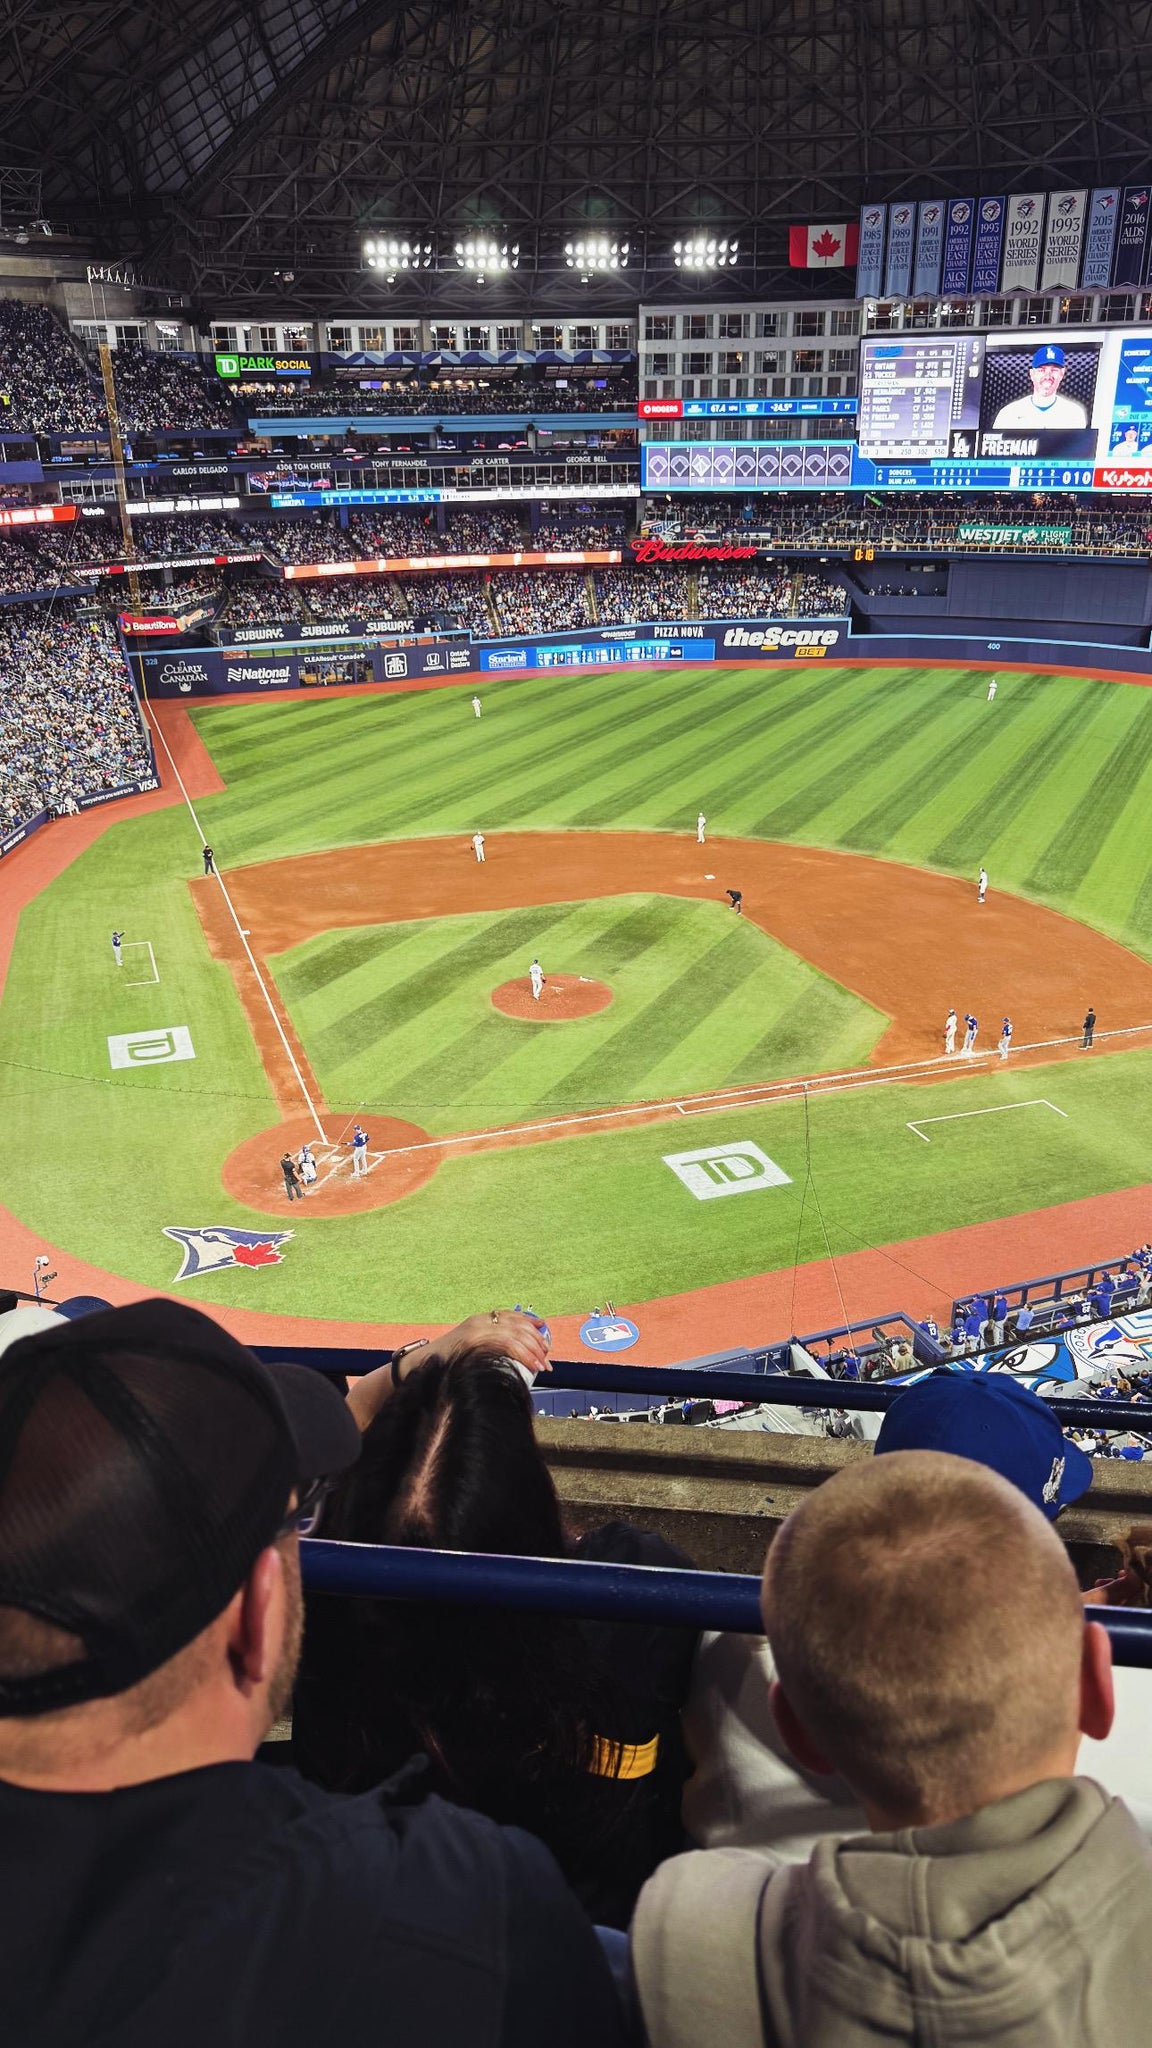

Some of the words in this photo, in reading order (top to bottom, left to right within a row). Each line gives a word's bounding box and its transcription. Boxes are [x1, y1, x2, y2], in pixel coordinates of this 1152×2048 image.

[1093, 215, 1113, 226] 2015
[1124, 214, 1145, 224] 2016
[950, 225, 969, 235] 1992
[981, 223, 1000, 233] 1993
[1010, 220, 1039, 236] 1992
[1051, 217, 1080, 233] 1993
[864, 231, 881, 240] 1985
[892, 229, 910, 239] 1989
[922, 227, 938, 237] 1991
[1123, 227, 1145, 237] ALDS
[1008, 238, 1038, 249] WORLD
[1049, 235, 1079, 246] WORLD
[1090, 235, 1112, 243] LEAGUE
[1121, 237, 1144, 245] CHAMPS
[890, 247, 910, 255] LEAGUE
[948, 244, 968, 252] LEAGUE
[978, 242, 999, 250] LEAGUE
[1089, 243, 1111, 251] EAST
[861, 248, 880, 256] LEAGUE
[947, 252, 968, 260] EAST
[977, 250, 998, 259] EAST
[1006, 249, 1037, 260] SERIES
[1047, 246, 1078, 257] SERIES
[889, 255, 909, 263] EAST
[919, 254, 938, 262] EAST
[1006, 258, 1036, 267] CHAMPIONS
[1046, 256, 1077, 265] CHAMPIONS
[1087, 264, 1108, 274] ALDS
[946, 272, 966, 282] ALCS
[976, 270, 996, 280] ALCS
[1085, 274, 1107, 282] CHAMPS
[974, 280, 996, 288] CHAMPS
[972, 342, 979, 354] 5
[217, 358, 237, 374] TD
[240, 357, 274, 369] PARK
[275, 360, 311, 370] SOCIAL
[652, 405, 678, 413] ROGERS
[833, 403, 838, 411] 7
[981, 438, 1038, 456] FREEMAN
[276, 462, 293, 471] 4306
[294, 462, 309, 471] TOM
[310, 462, 331, 470] CHEEK
[372, 460, 390, 468] TONY
[392, 459, 427, 467] FERNANDEZ
[172, 467, 197, 476] CARLOS
[199, 466, 228, 474] DELGADO
[888, 478, 903, 486] BLUE
[903, 478, 917, 486] JAYS
[959, 528, 1022, 545] WESTJET
[1041, 530, 1070, 539] FLIGHT
[631, 540, 758, 563] Budweiser
[80, 567, 102, 576] ROGERS
[124, 564, 144, 572] PROUD
[143, 562, 163, 571] OWNER
[163, 561, 171, 569] OF
[200, 557, 215, 565] TEAM
[233, 554, 253, 563] ROGERS
[133, 621, 177, 631] BeautiTone
[301, 624, 350, 638] SUBWAY
[366, 620, 415, 634] SUBWAY
[234, 628, 285, 643] SUBWAY
[654, 626, 679, 638] PIZZA
[681, 626, 704, 638] NOVA
[723, 626, 839, 647] theScore
[450, 649, 470, 657] Ontario
[798, 648, 824, 656] BET
[145, 658, 158, 666] 328
[304, 655, 338, 664] CLEAResult
[164, 664, 203, 674] CLEARLY
[242, 666, 291, 680] National
[160, 672, 208, 684] CANADIAN
[137, 779, 159, 792] VISA
[681, 1153, 765, 1185] TD
